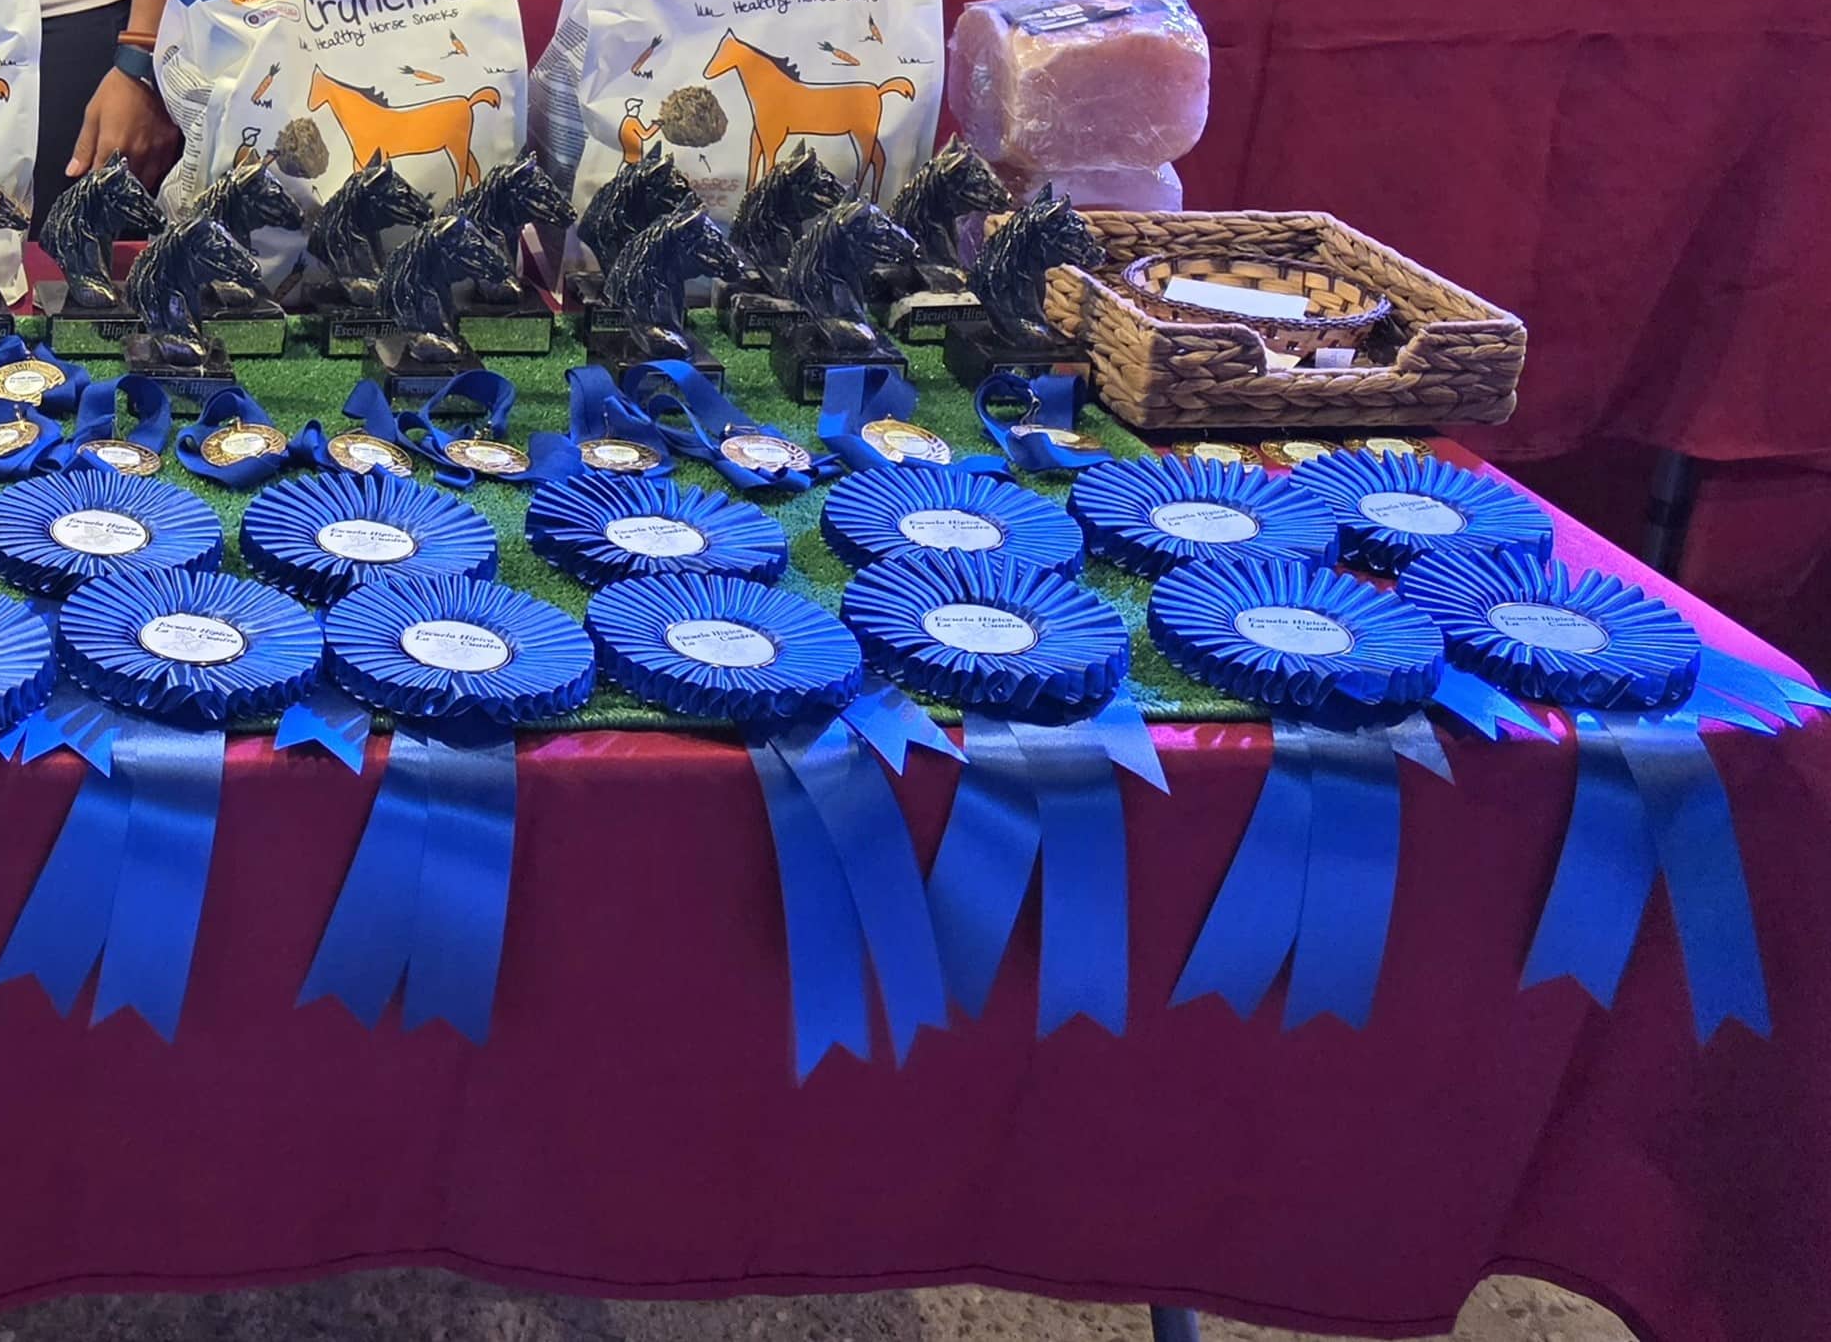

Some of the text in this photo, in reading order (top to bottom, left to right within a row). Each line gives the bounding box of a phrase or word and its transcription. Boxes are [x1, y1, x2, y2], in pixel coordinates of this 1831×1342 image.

[315, 9, 459, 51] Healthy Horse Snacks
